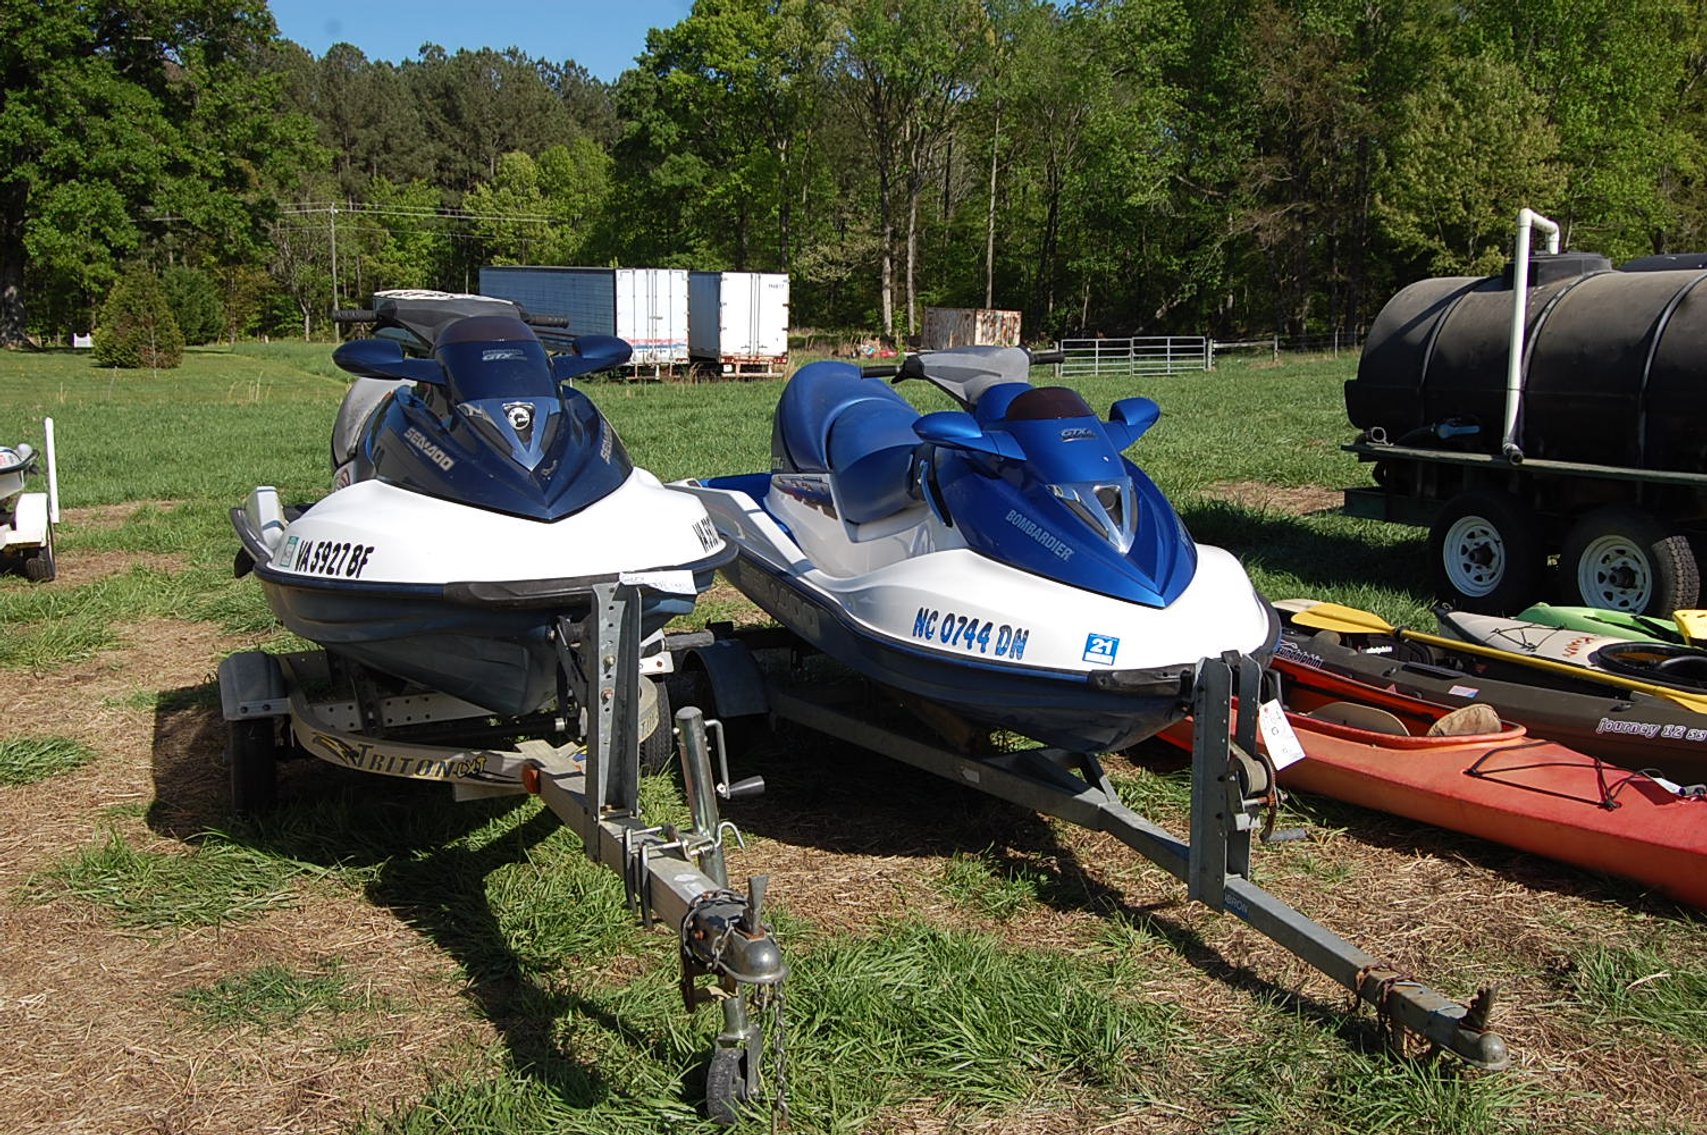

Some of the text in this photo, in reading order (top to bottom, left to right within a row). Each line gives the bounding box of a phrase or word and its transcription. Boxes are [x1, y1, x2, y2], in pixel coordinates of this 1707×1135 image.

[1005, 509, 1075, 561] BOMBARDIER
[294, 540, 314, 573] VA
[310, 541, 351, 576] 5927
[345, 544, 375, 579] BF
[912, 607, 1030, 660] NC 0744 DN
[1089, 639, 1113, 655] 21
[1596, 717, 1662, 739] journey
[1661, 724, 1687, 739] 12
[357, 743, 488, 780] TRITON LXT
